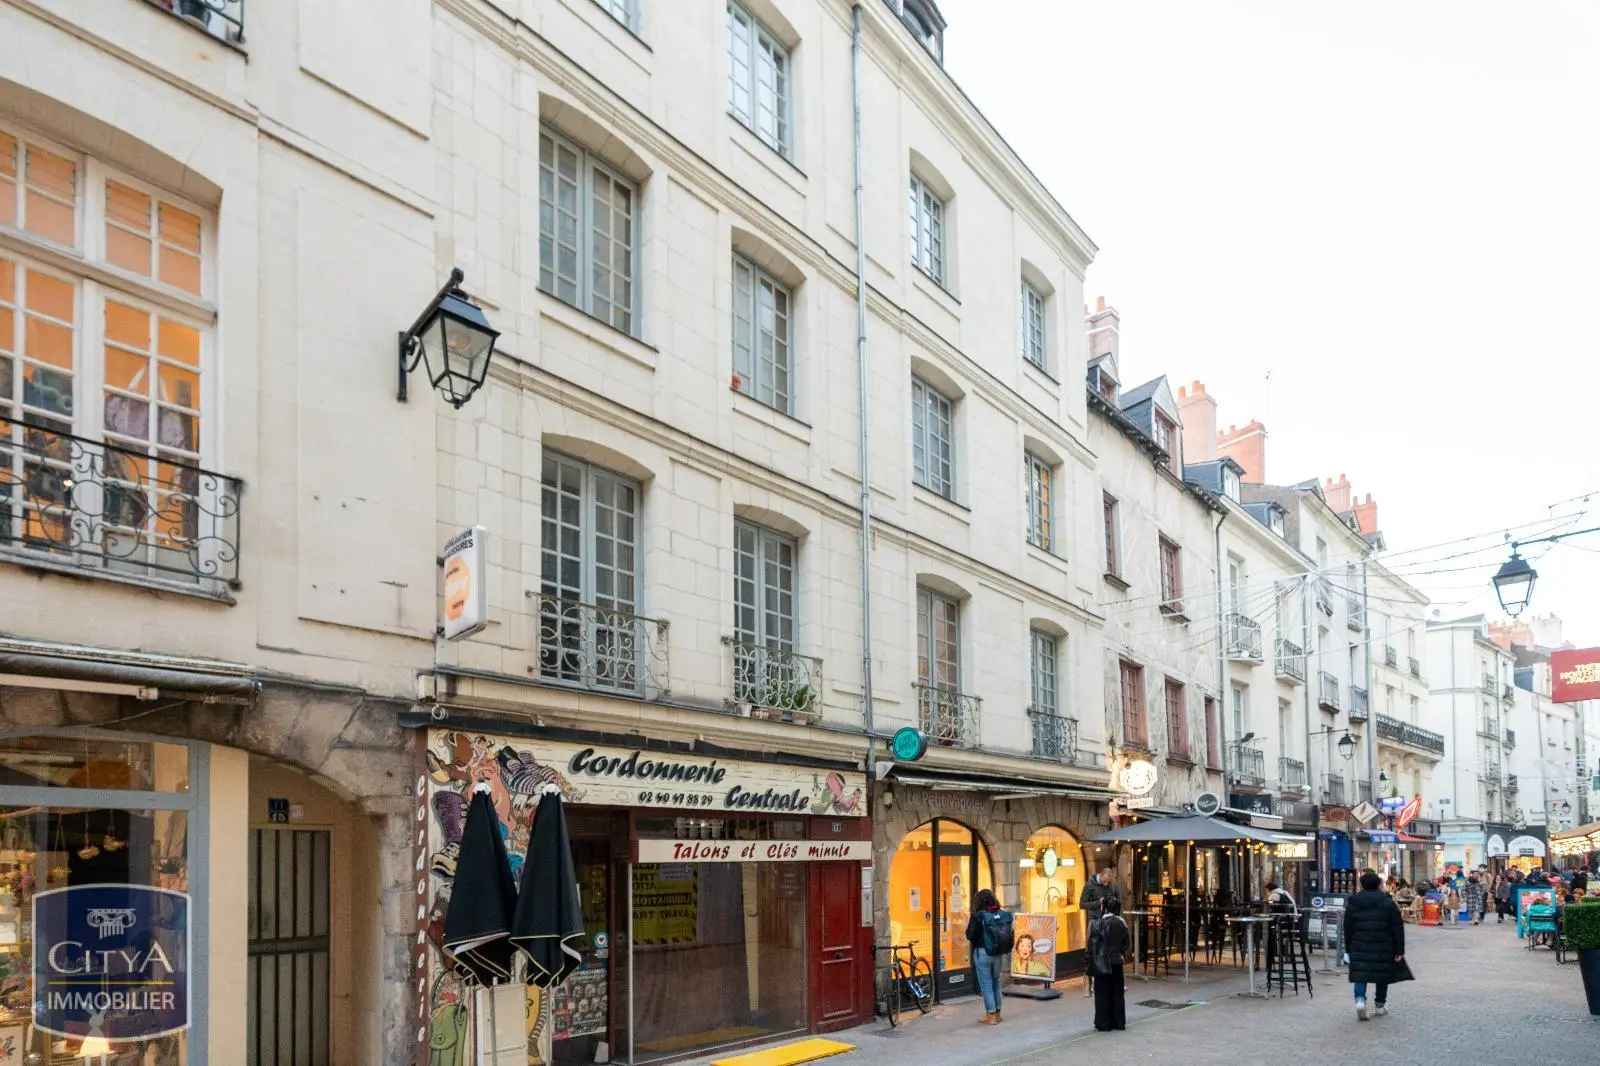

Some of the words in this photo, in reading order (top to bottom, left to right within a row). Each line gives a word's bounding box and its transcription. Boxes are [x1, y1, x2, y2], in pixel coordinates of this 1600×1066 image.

[568, 748, 726, 784] Cordonnerie
[638, 791, 653, 804] 02
[655, 792, 670, 805] 40
[700, 795, 713, 808] 29
[724, 785, 810, 812] Centrale
[673, 842, 731, 859] Talons
[741, 843, 756, 859] et
[767, 843, 799, 859] Clés
[808, 843, 850, 859] minute
[416, 775, 426, 1042] Cordonnerie
